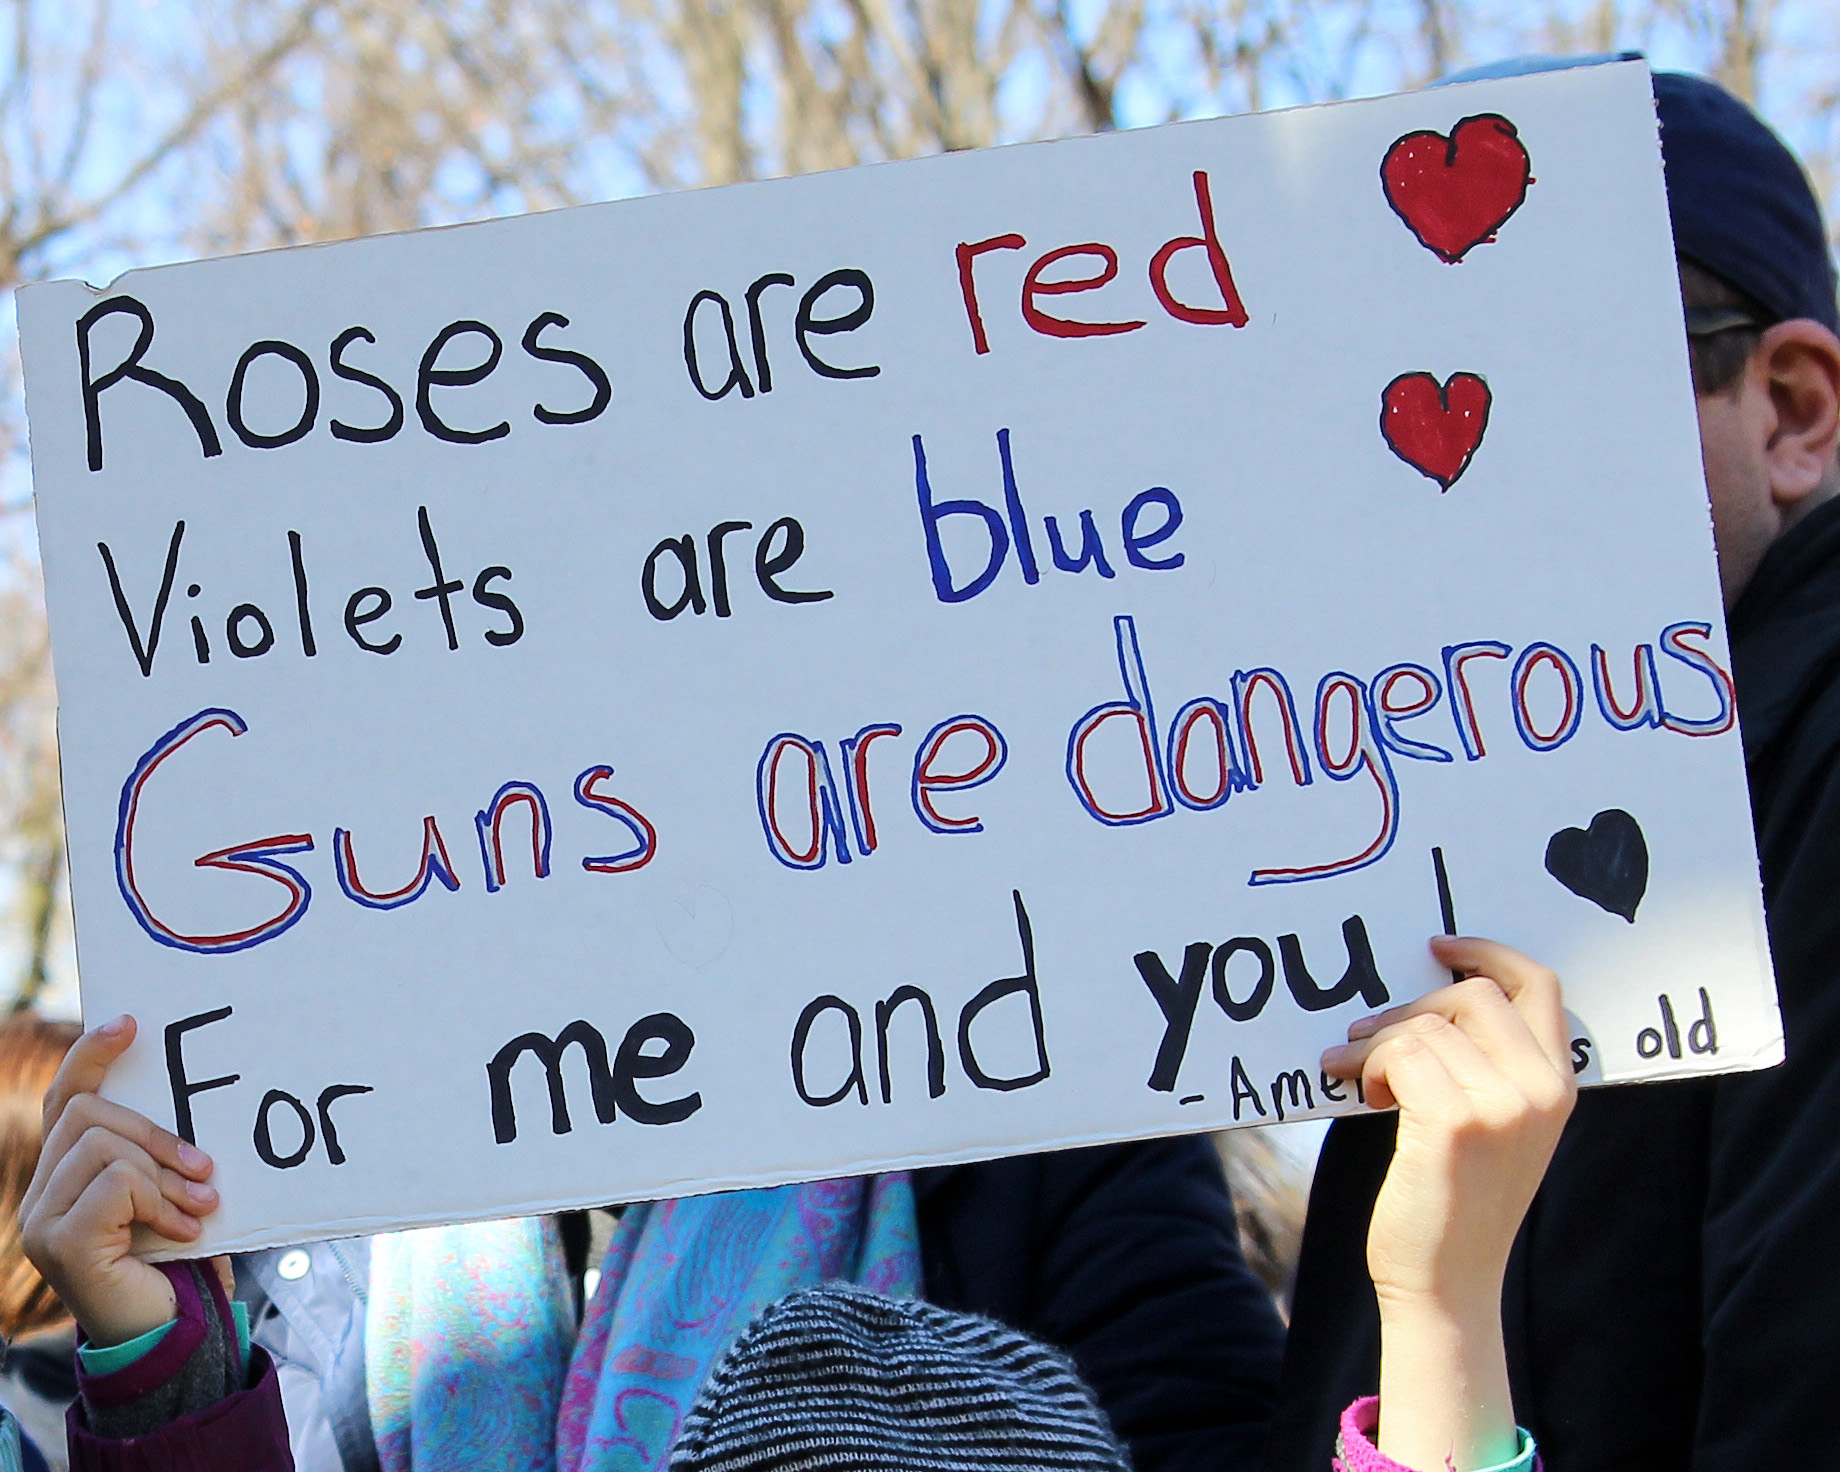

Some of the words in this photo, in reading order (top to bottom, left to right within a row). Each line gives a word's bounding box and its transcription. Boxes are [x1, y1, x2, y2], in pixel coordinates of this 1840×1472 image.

[75, 295, 613, 472] Roses
[683, 267, 881, 401] are
[955, 170, 1250, 355] red
[97, 505, 526, 677] Violets
[641, 516, 834, 621] are
[911, 427, 1186, 604] blue
[113, 707, 657, 955] Guns
[756, 713, 1008, 870] are
[1065, 614, 1737, 886] dangerous
[164, 1005, 374, 1170] For
[487, 1011, 703, 1145] me
[791, 888, 1052, 1108] and
[1636, 987, 1719, 1059] old
